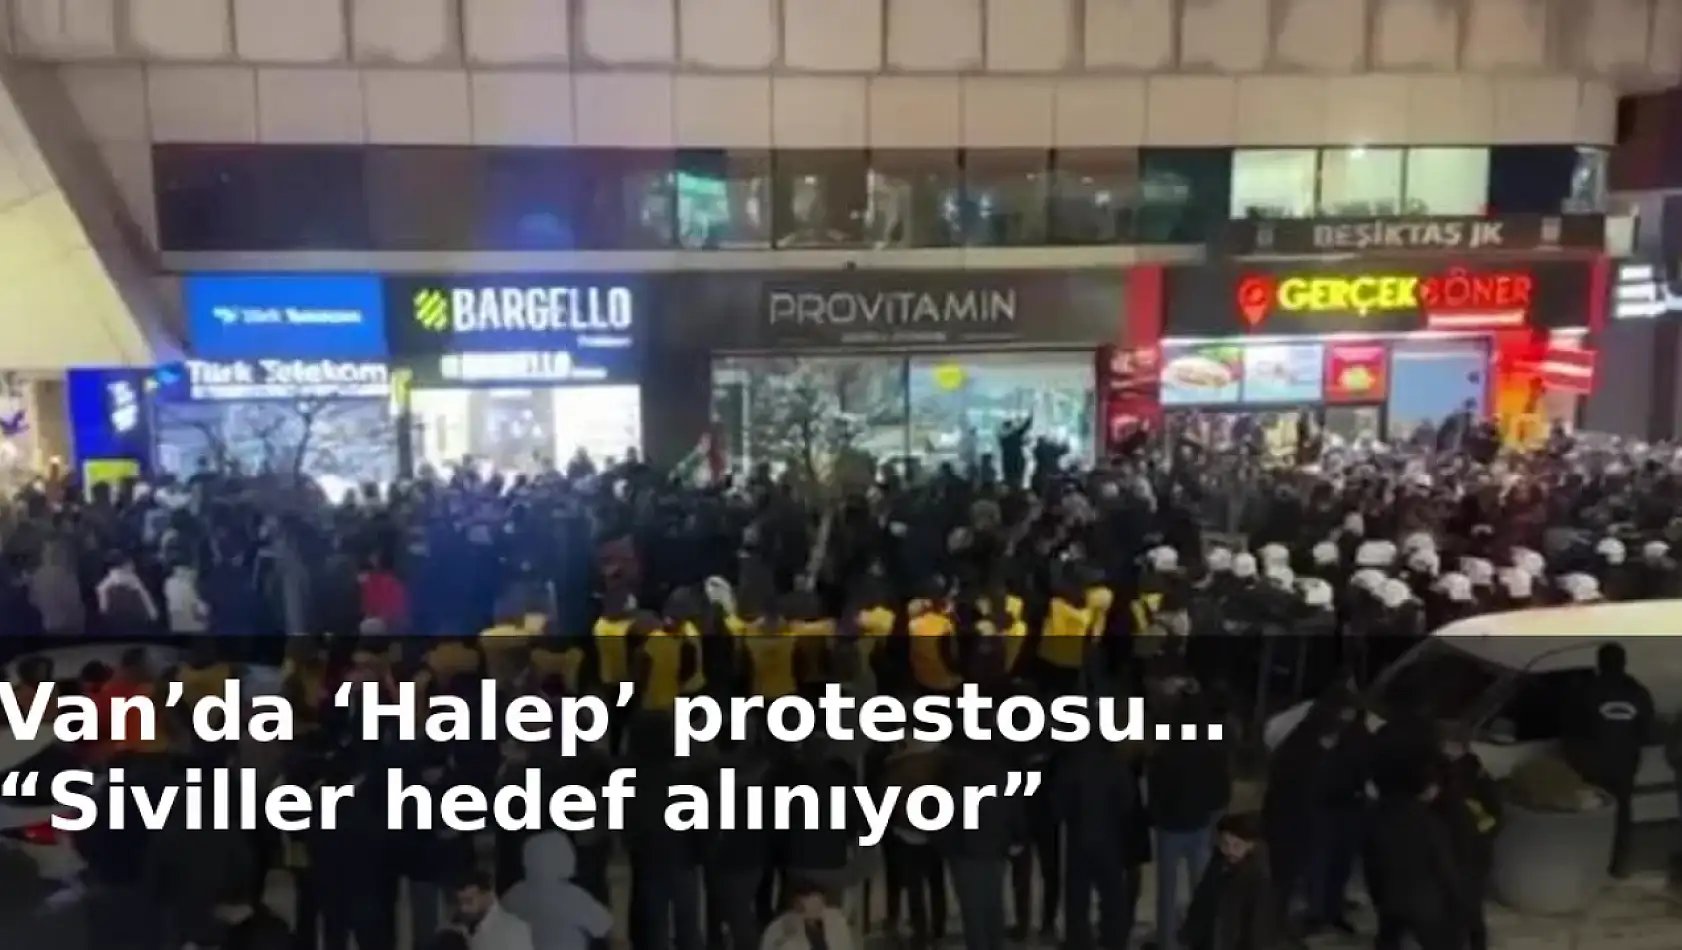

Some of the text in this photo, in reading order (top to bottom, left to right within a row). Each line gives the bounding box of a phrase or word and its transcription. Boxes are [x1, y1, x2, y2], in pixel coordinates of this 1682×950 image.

[1468, 220, 1505, 247] JK
[452, 286, 633, 333] BARGELLO
[1277, 275, 1419, 316] GERÇEK
